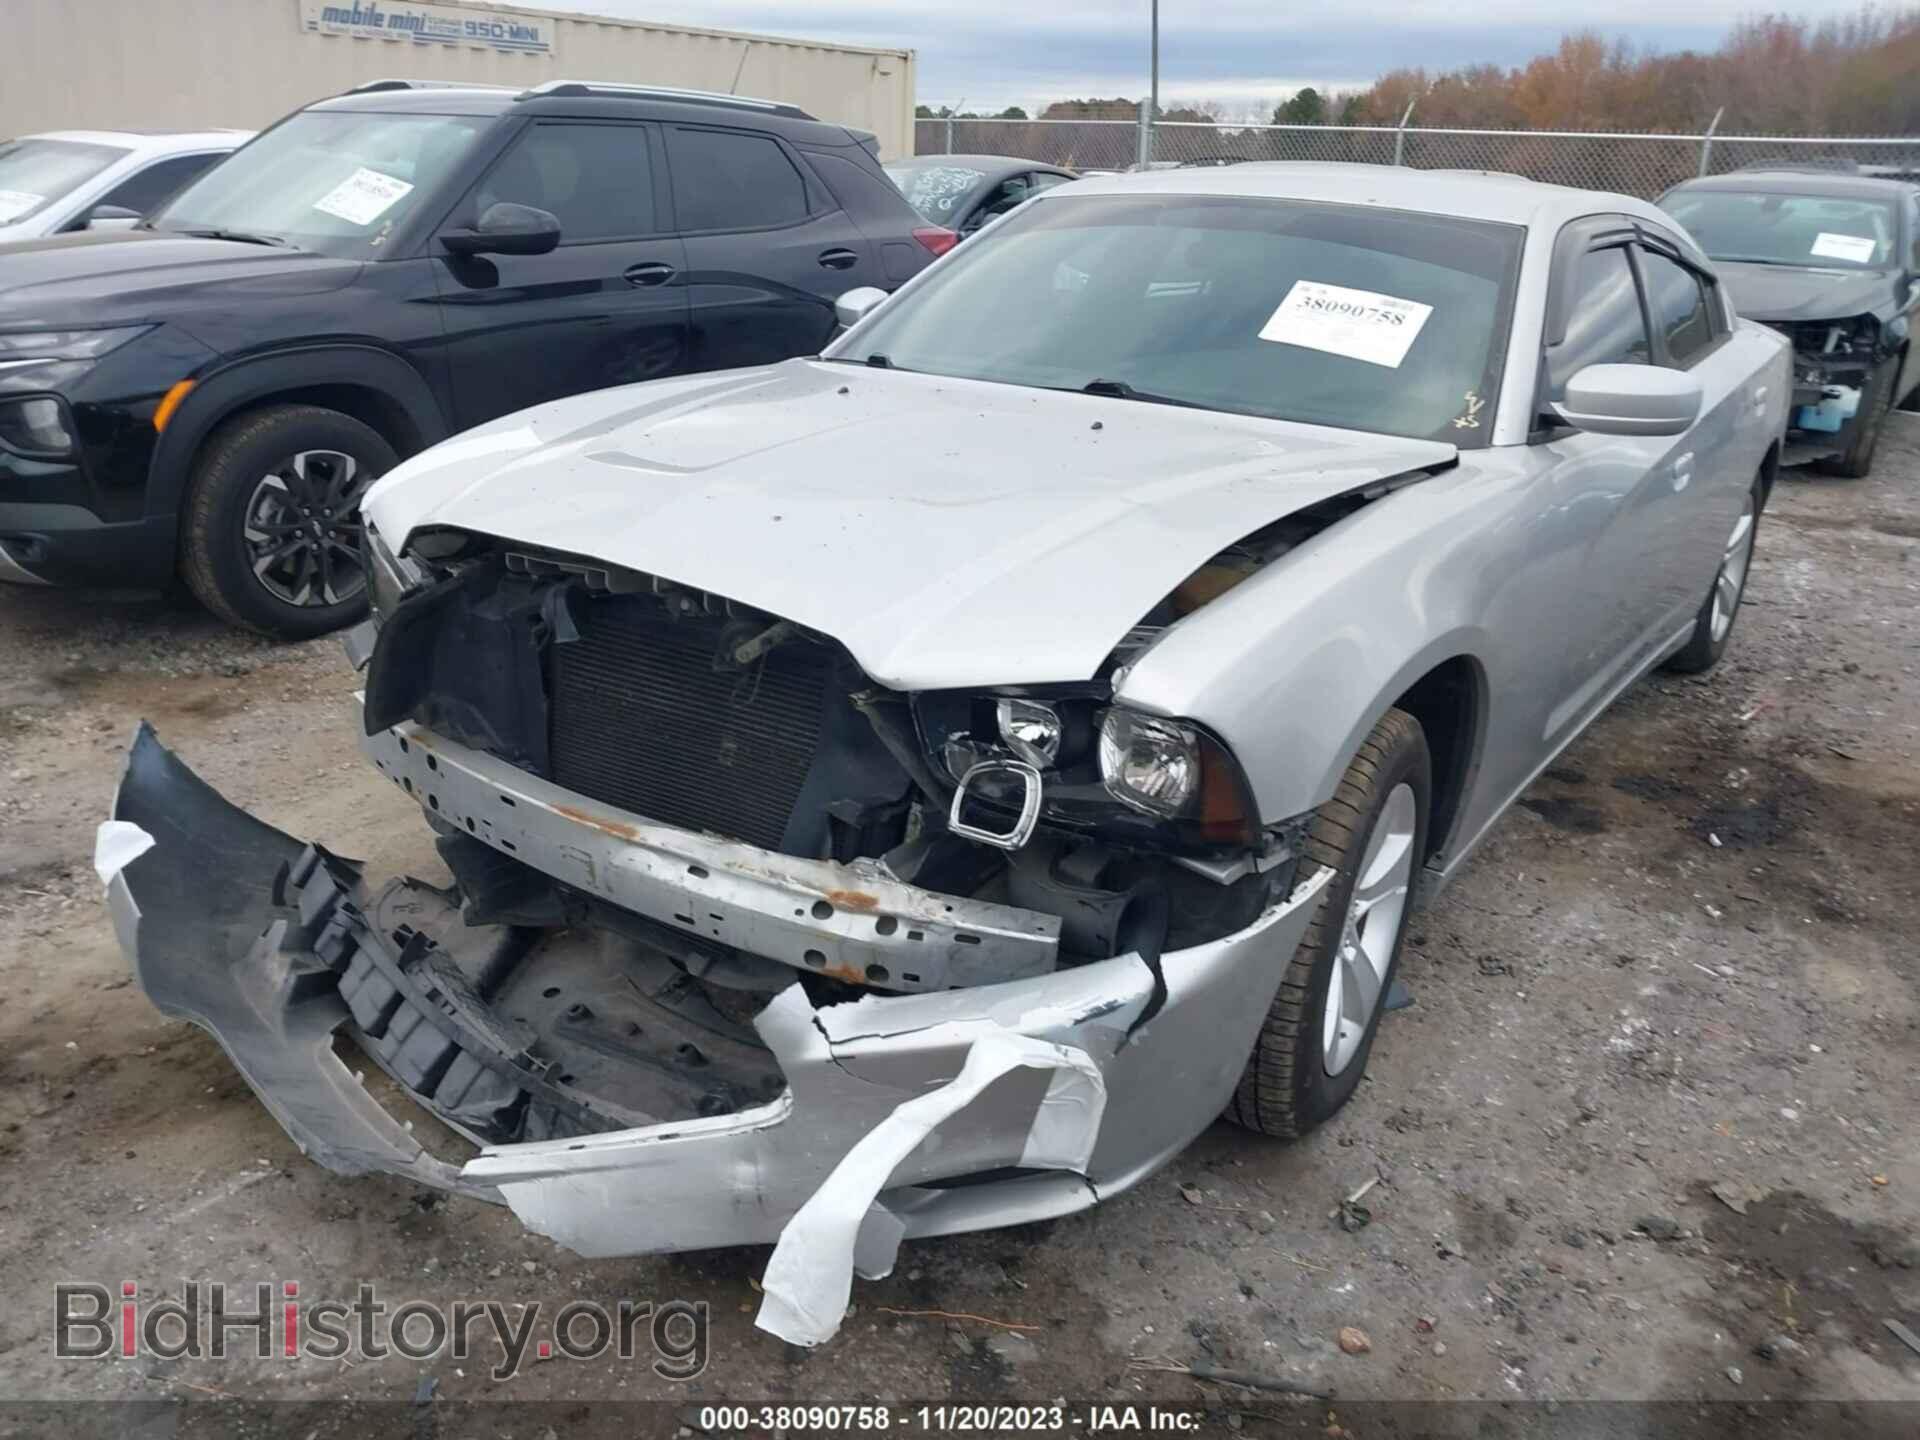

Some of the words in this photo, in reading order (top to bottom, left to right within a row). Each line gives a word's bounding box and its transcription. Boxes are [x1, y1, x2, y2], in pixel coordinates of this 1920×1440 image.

[321, 0, 385, 28] mobile
[387, 11, 427, 32] mini
[1296, 296, 1406, 326] 38090758
